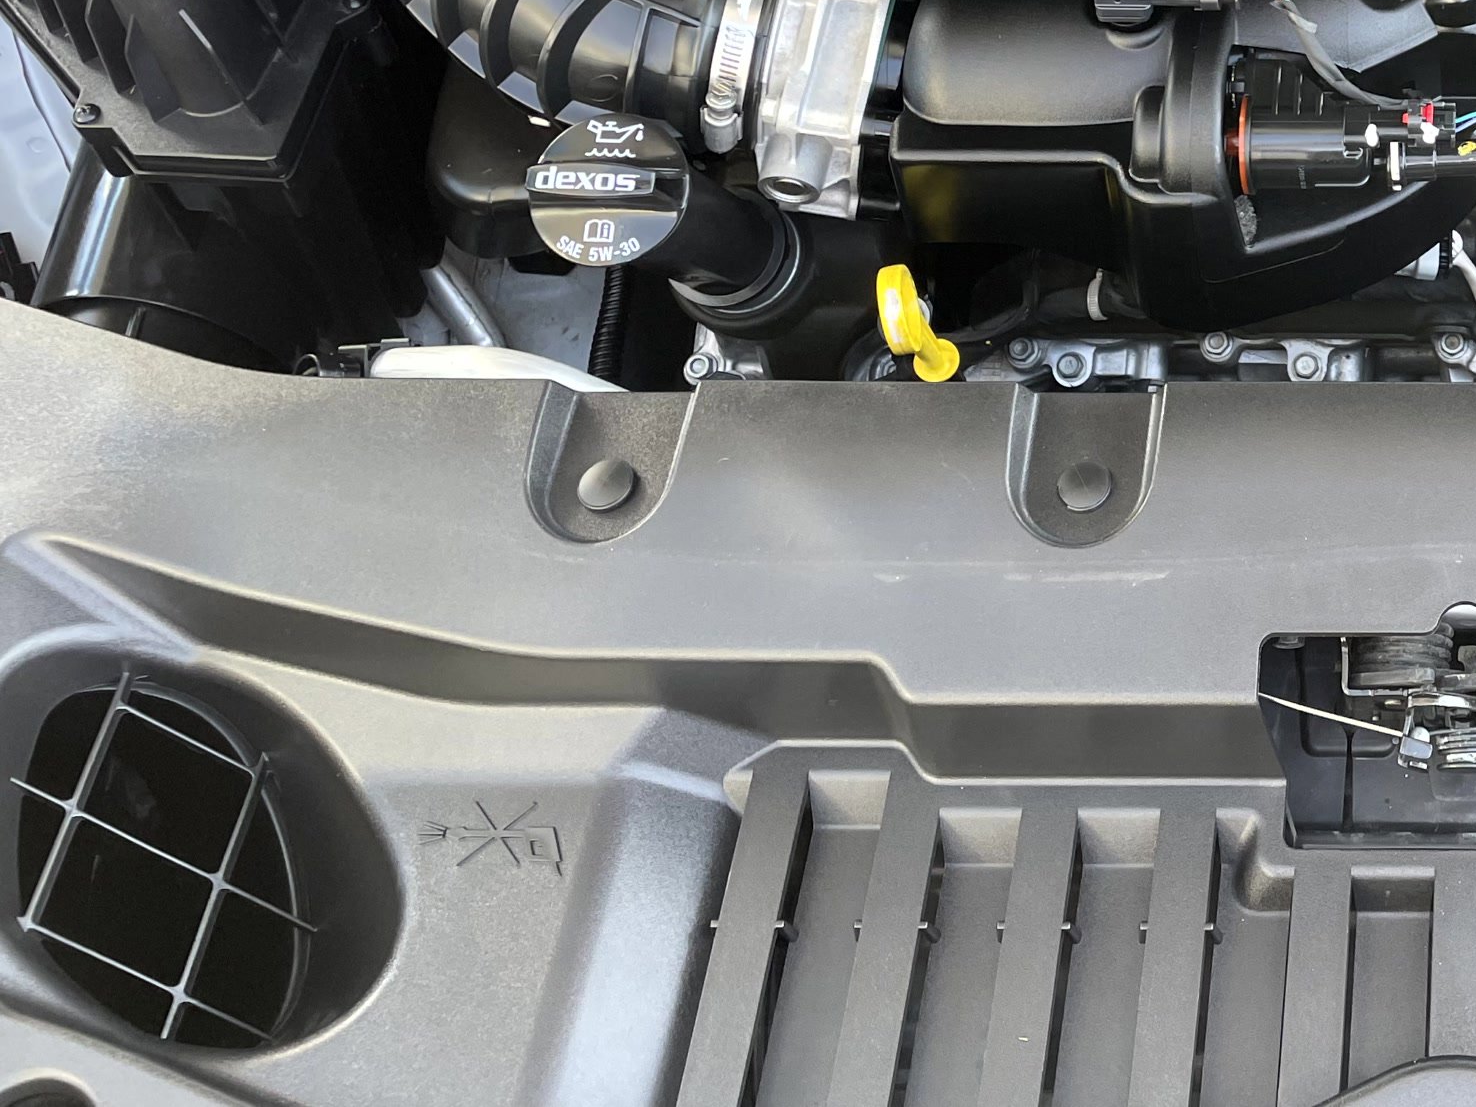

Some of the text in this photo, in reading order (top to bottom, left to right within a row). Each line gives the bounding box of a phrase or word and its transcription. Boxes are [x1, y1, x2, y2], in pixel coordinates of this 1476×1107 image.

[534, 165, 640, 192] dexos
[556, 235, 640, 262] SAE 5W-30
